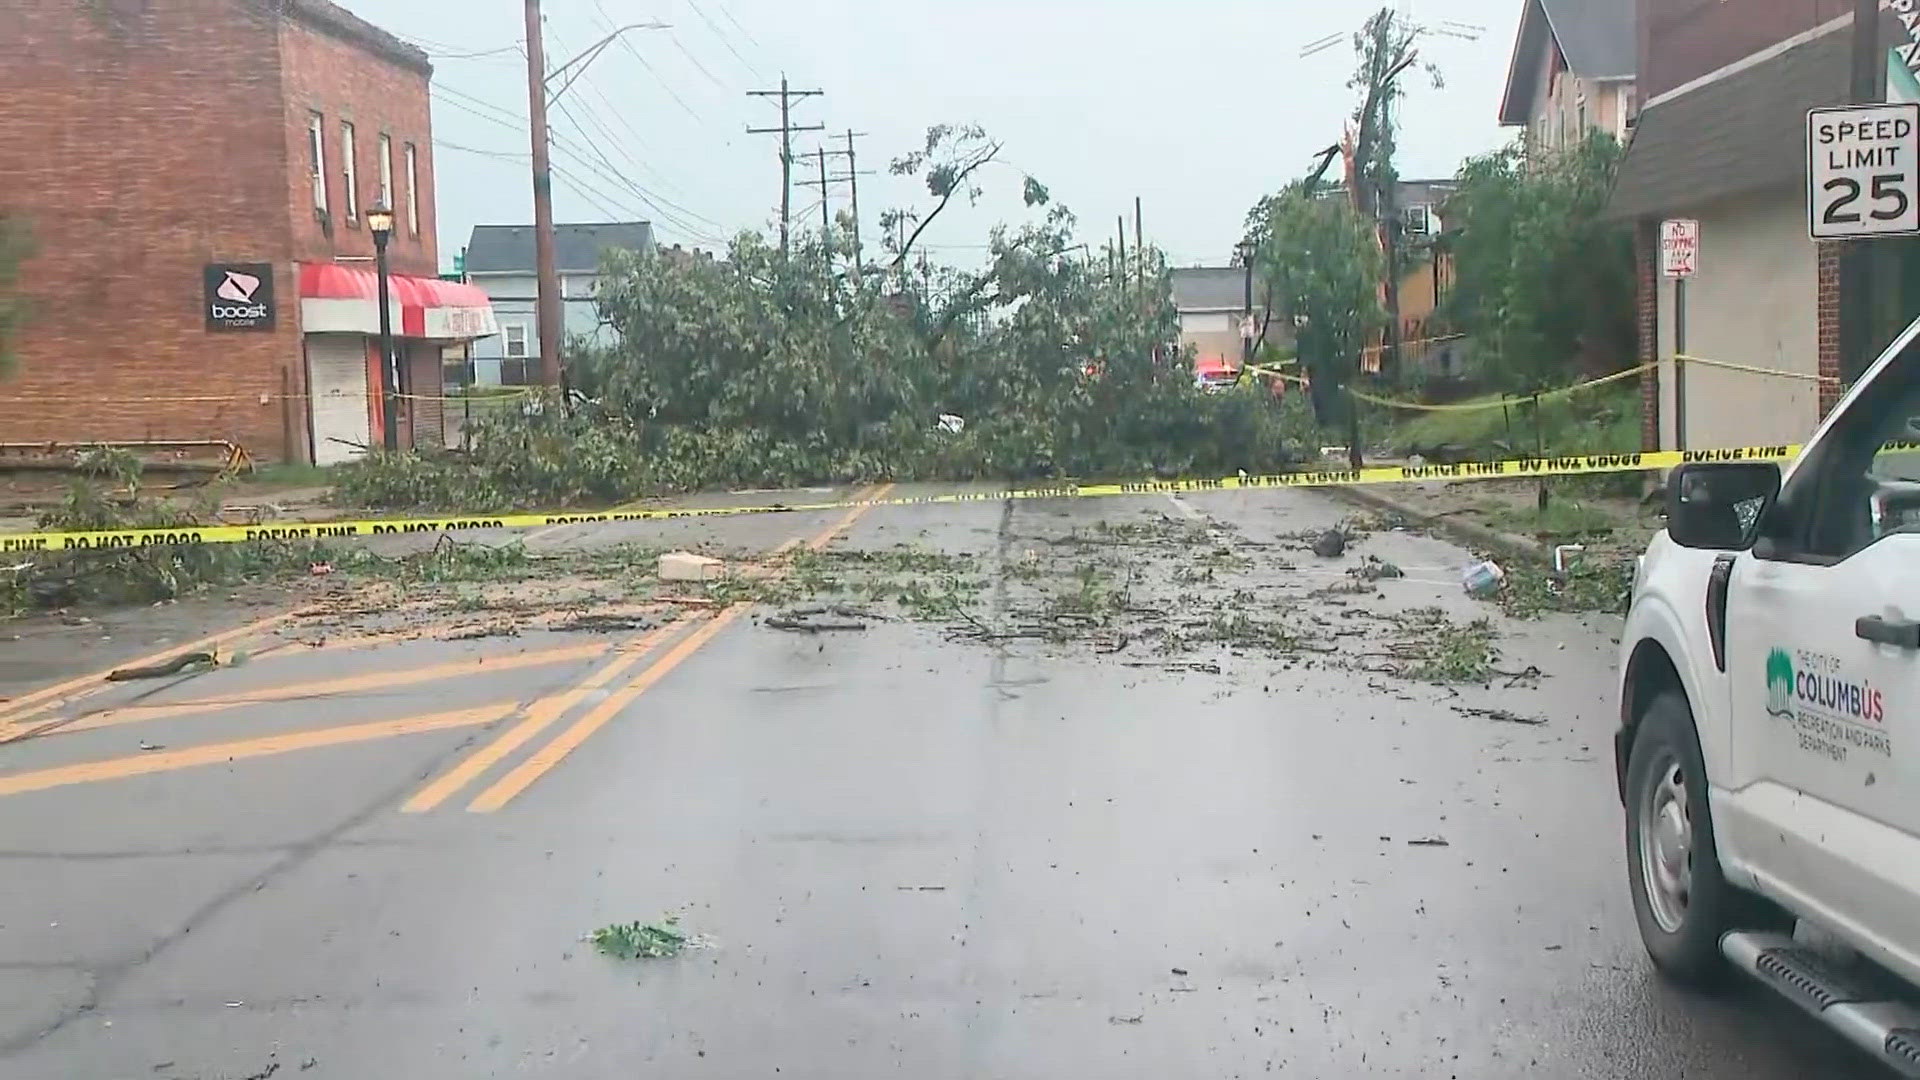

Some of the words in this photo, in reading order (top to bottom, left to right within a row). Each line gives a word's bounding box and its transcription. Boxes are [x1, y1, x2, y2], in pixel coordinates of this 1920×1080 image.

[1819, 119, 1911, 144] SPEED
[1829, 146, 1901, 170] LIMIT
[1823, 173, 1908, 225] 25
[1672, 225, 1685, 237] NO
[1663, 237, 1695, 250] STOPPING
[212, 303, 267, 319] boost
[224, 318, 255, 327] mobile
[1796, 670, 1884, 723] COLUMBUS
[1864, 732, 1892, 758] PARKS
